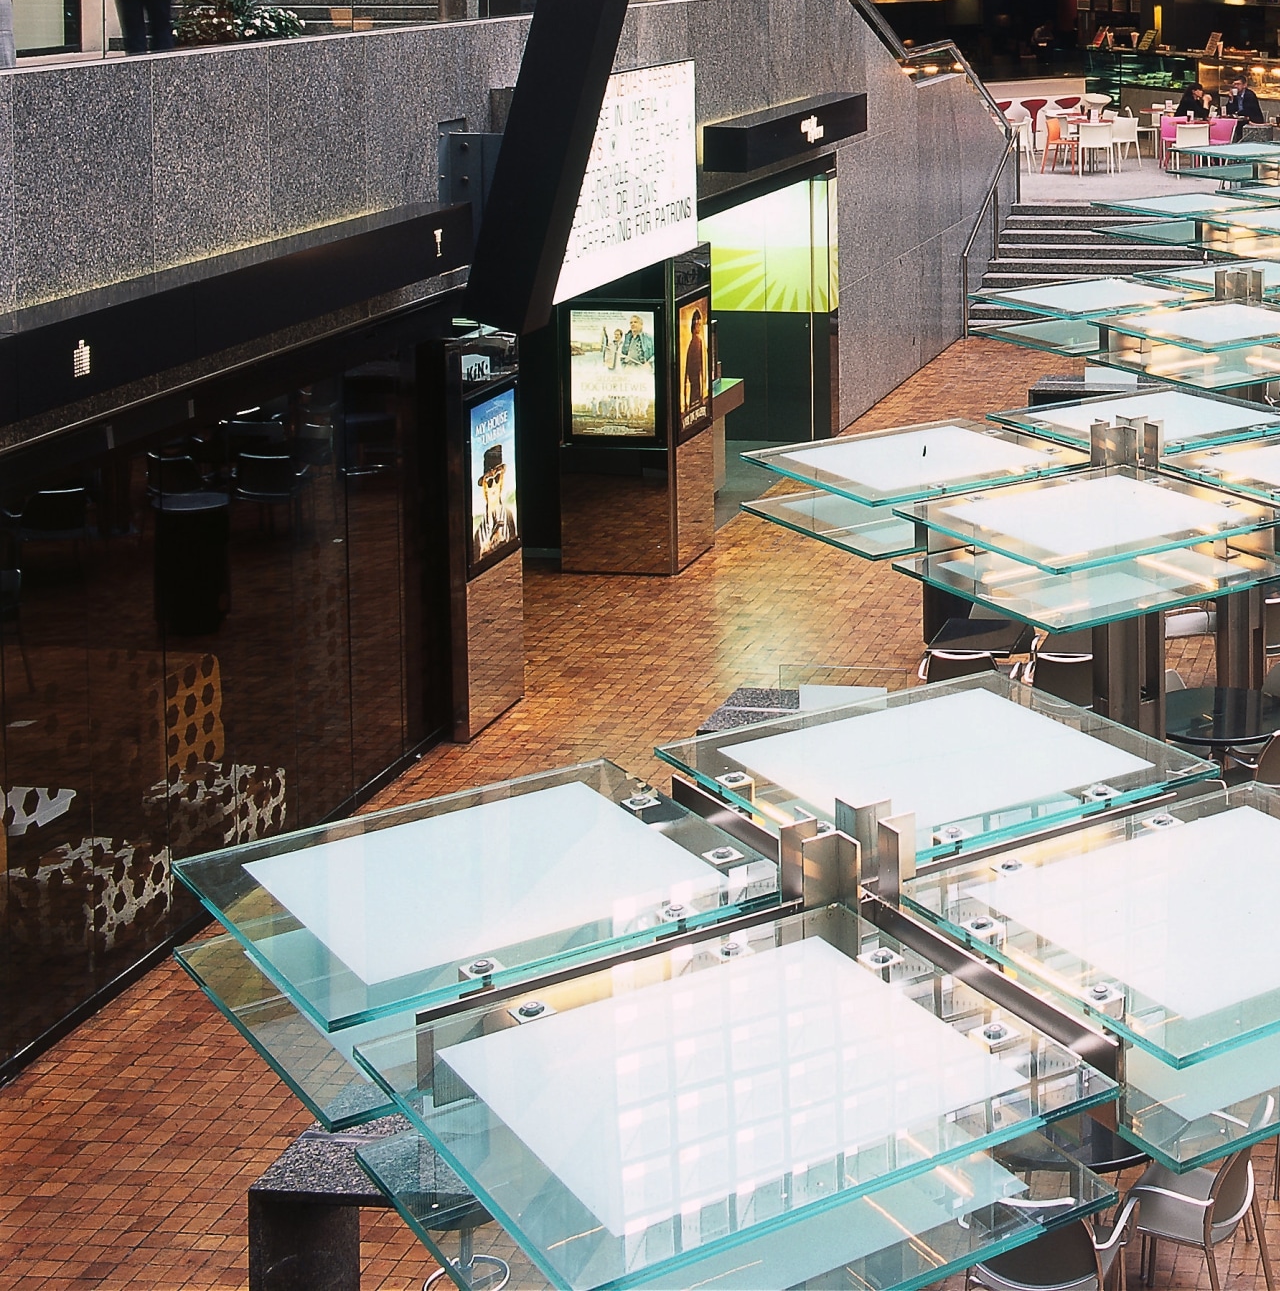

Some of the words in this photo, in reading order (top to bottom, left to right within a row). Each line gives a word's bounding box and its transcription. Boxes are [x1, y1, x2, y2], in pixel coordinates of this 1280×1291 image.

[635, 211, 652, 237] FOR
[655, 197, 692, 229] PATRONS
[488, 411, 508, 430] HOUSE
